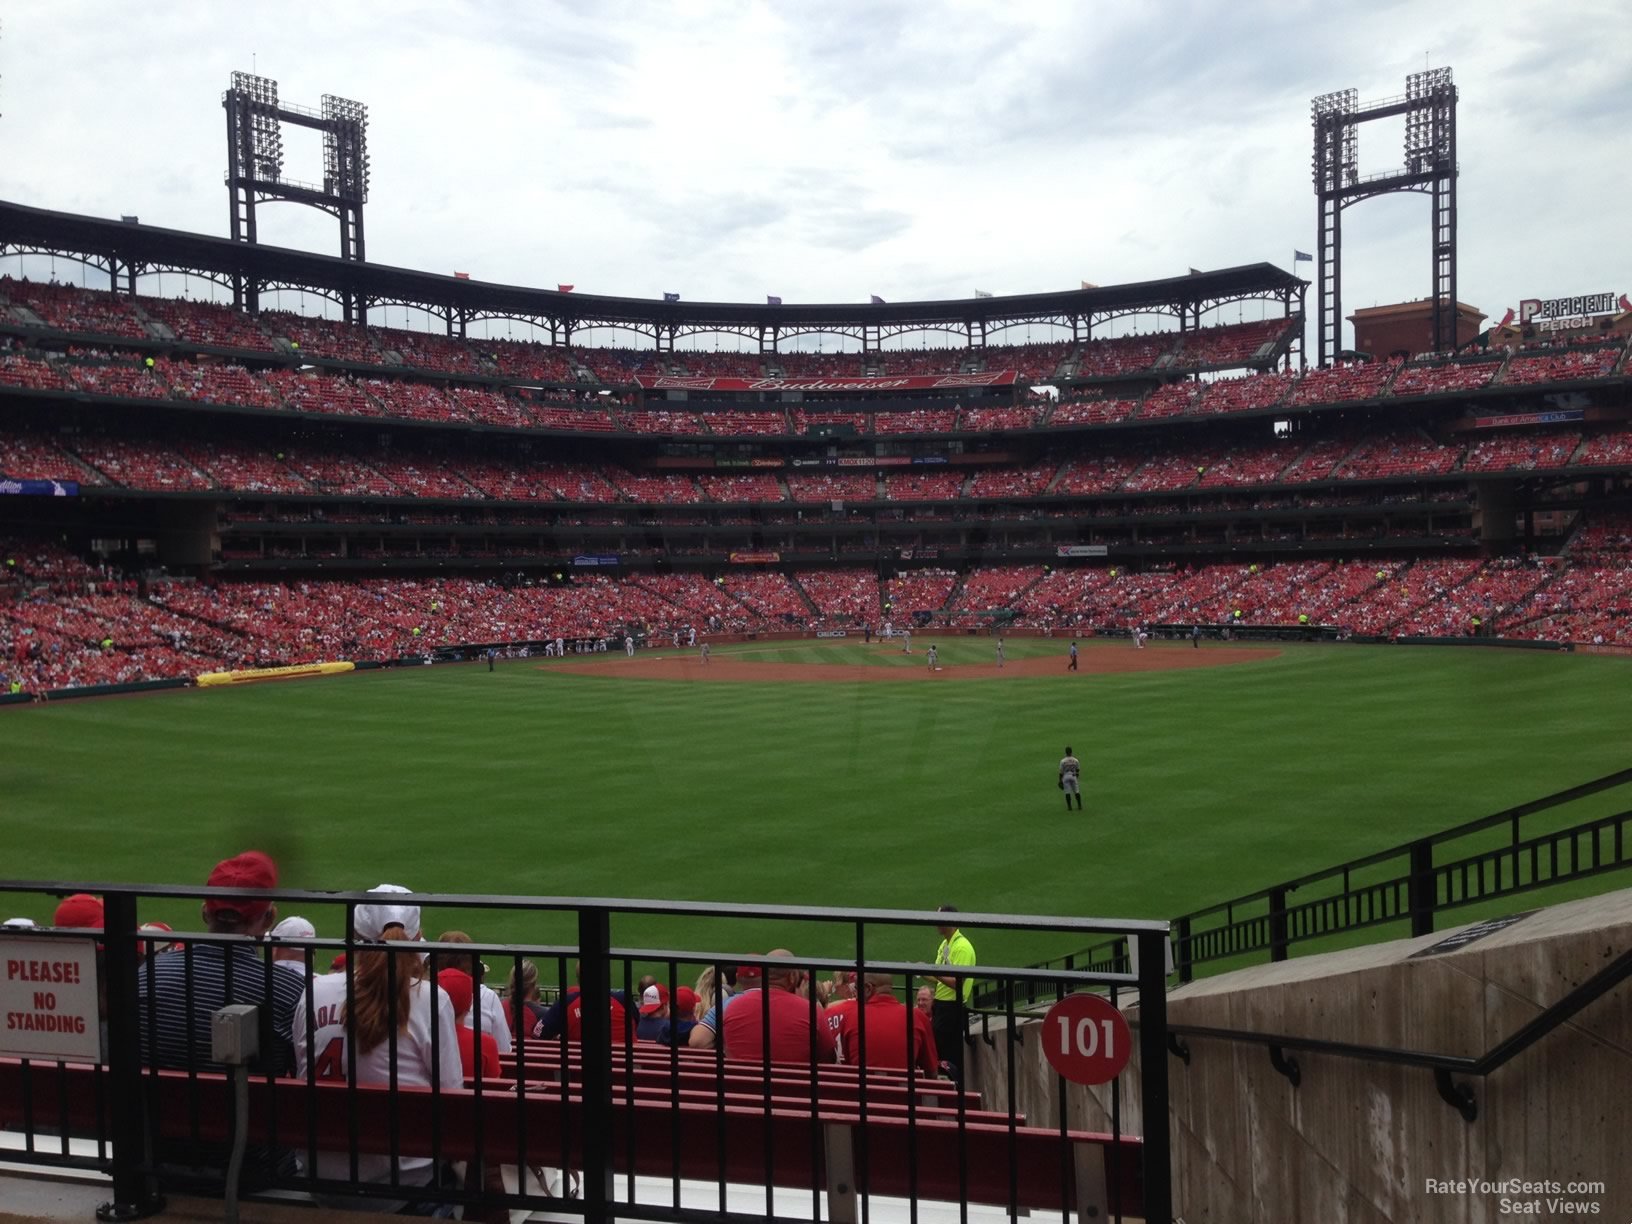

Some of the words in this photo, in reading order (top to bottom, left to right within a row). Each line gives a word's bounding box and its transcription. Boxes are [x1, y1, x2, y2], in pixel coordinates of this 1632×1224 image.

[1520, 292, 1614, 325] PERFICIENT
[1540, 317, 1593, 332] PERCH
[745, 377, 909, 391] Budweiser
[1550, 413, 1566, 421] Club
[7, 960, 80, 984] PLEASE!
[34, 992, 56, 1010] NO
[7, 1012, 85, 1034] STANDING
[1057, 1016, 1114, 1058] 101
